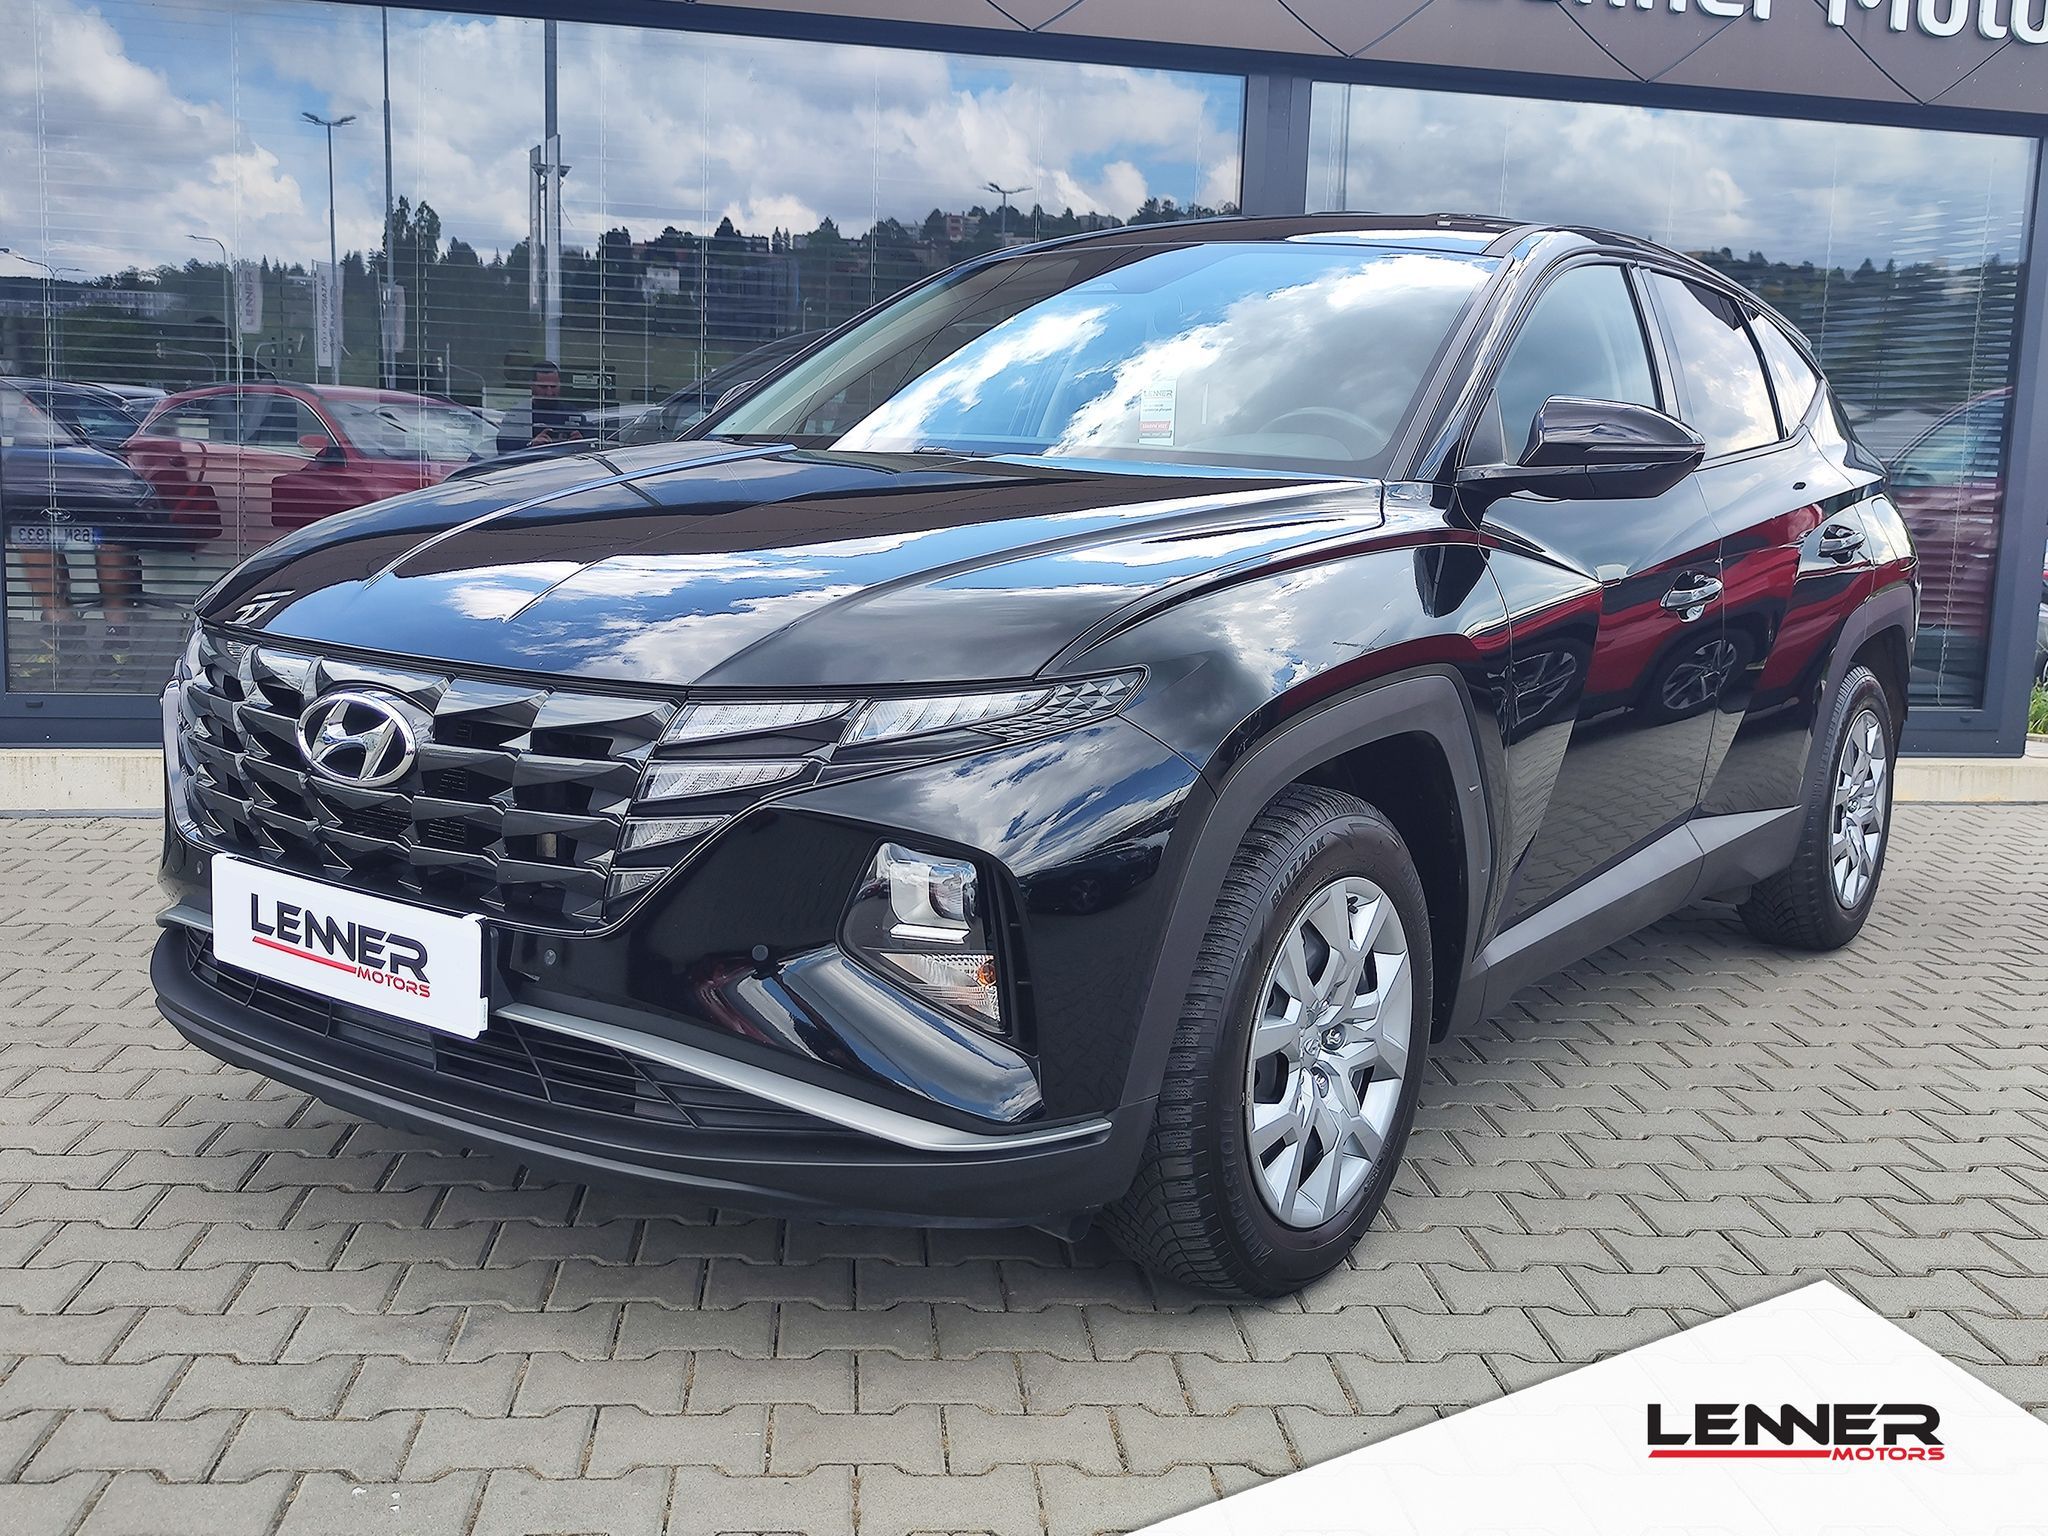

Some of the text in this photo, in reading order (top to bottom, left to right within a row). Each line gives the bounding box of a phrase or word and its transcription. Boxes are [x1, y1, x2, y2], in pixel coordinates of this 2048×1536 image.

[1271, 835, 1326, 911] BLIZZAK
[251, 893, 431, 983] LENNER
[357, 966, 431, 998] MOTORS
